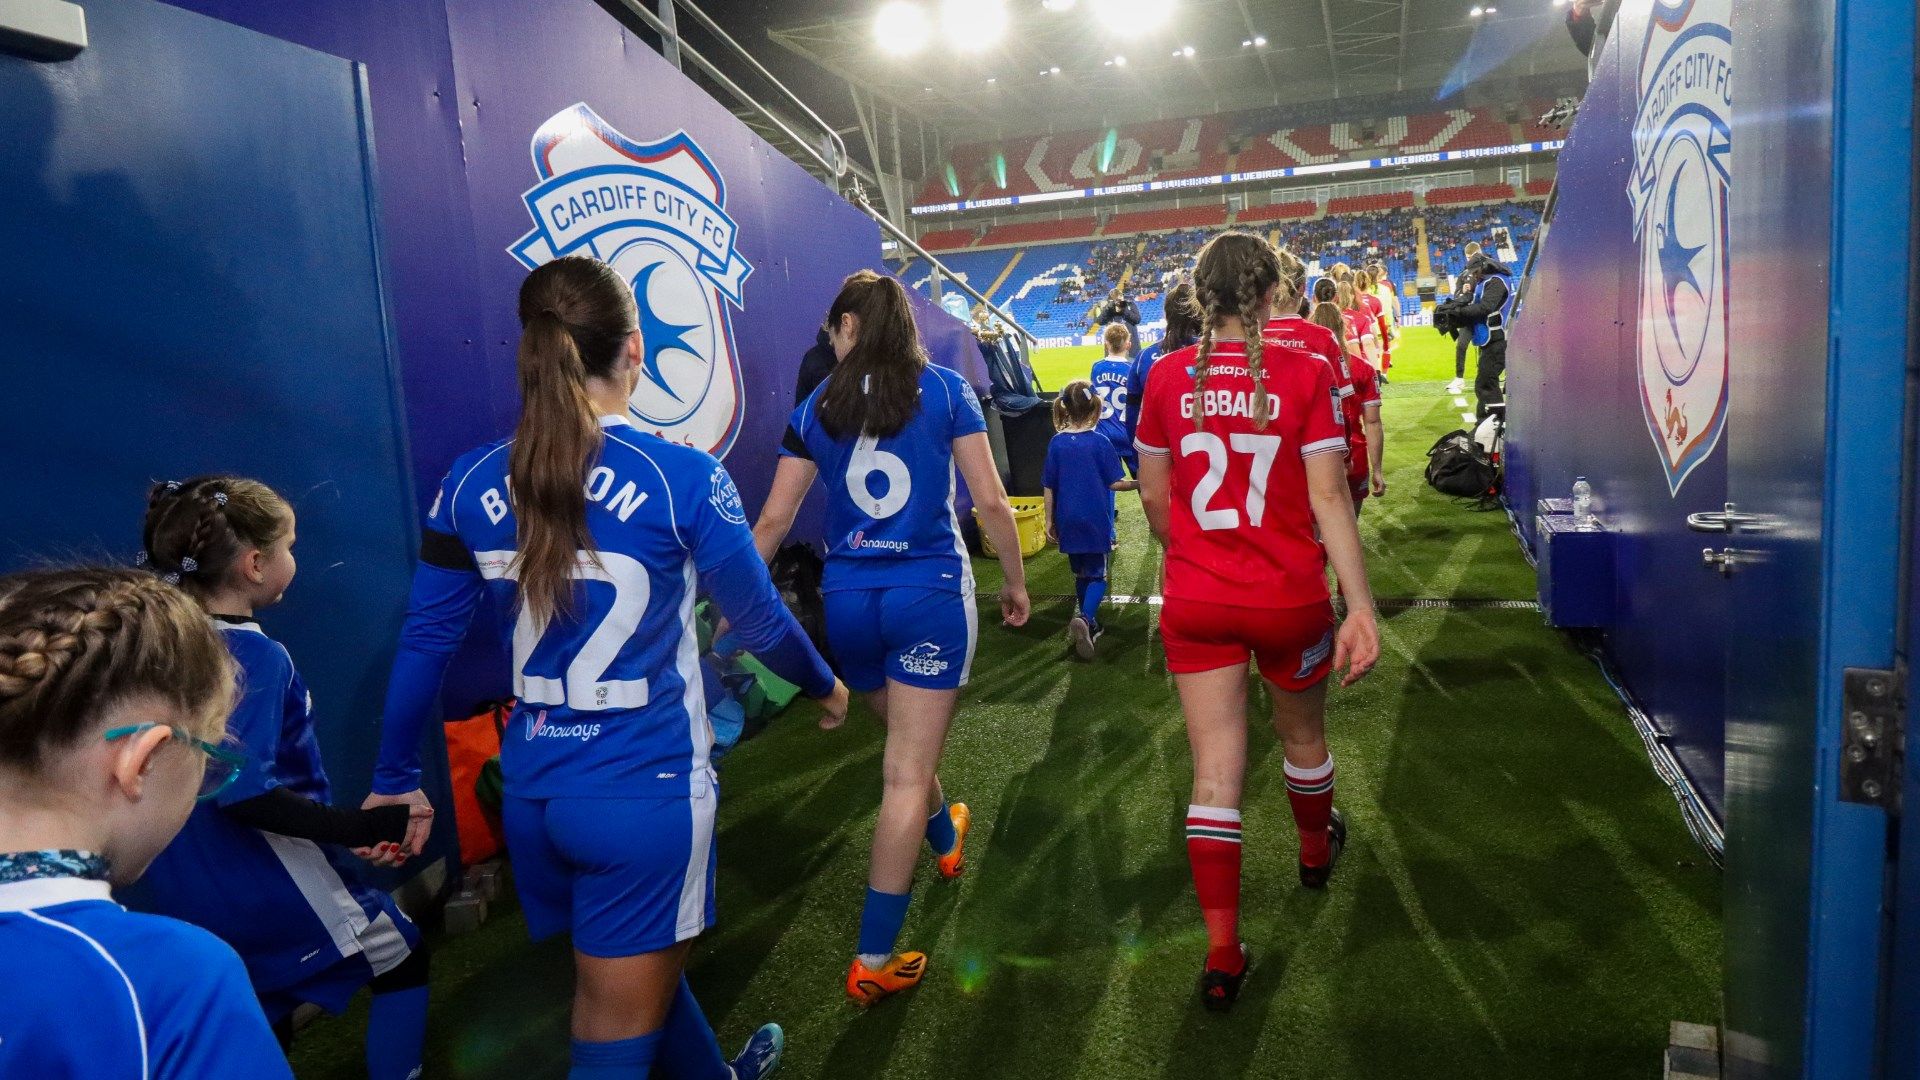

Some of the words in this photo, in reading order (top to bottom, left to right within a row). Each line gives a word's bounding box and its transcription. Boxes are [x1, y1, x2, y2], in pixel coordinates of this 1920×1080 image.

[1641, 62, 1682, 157] CARDIFF
[1684, 53, 1714, 90] CITY
[965, 197, 1012, 209] BLUEBIRDS
[1093, 183, 1143, 196] BLUEBIRDS
[1231, 169, 1285, 181] BLUEBIRDS
[1381, 153, 1440, 167] BLUEBIRDS
[551, 185, 647, 231] CARDIFF
[654, 191, 699, 227] CITY
[702, 215, 724, 249] FC
[1095, 386, 1128, 422] 39
[1180, 390, 1281, 420] GBBAD
[479, 466, 648, 526] BON
[846, 430, 912, 520] 6
[1180, 432, 1282, 531] 27
[847, 530, 909, 553] Vanaways
[474, 549, 651, 712] 22
[523, 709, 601, 742] Vanaways
